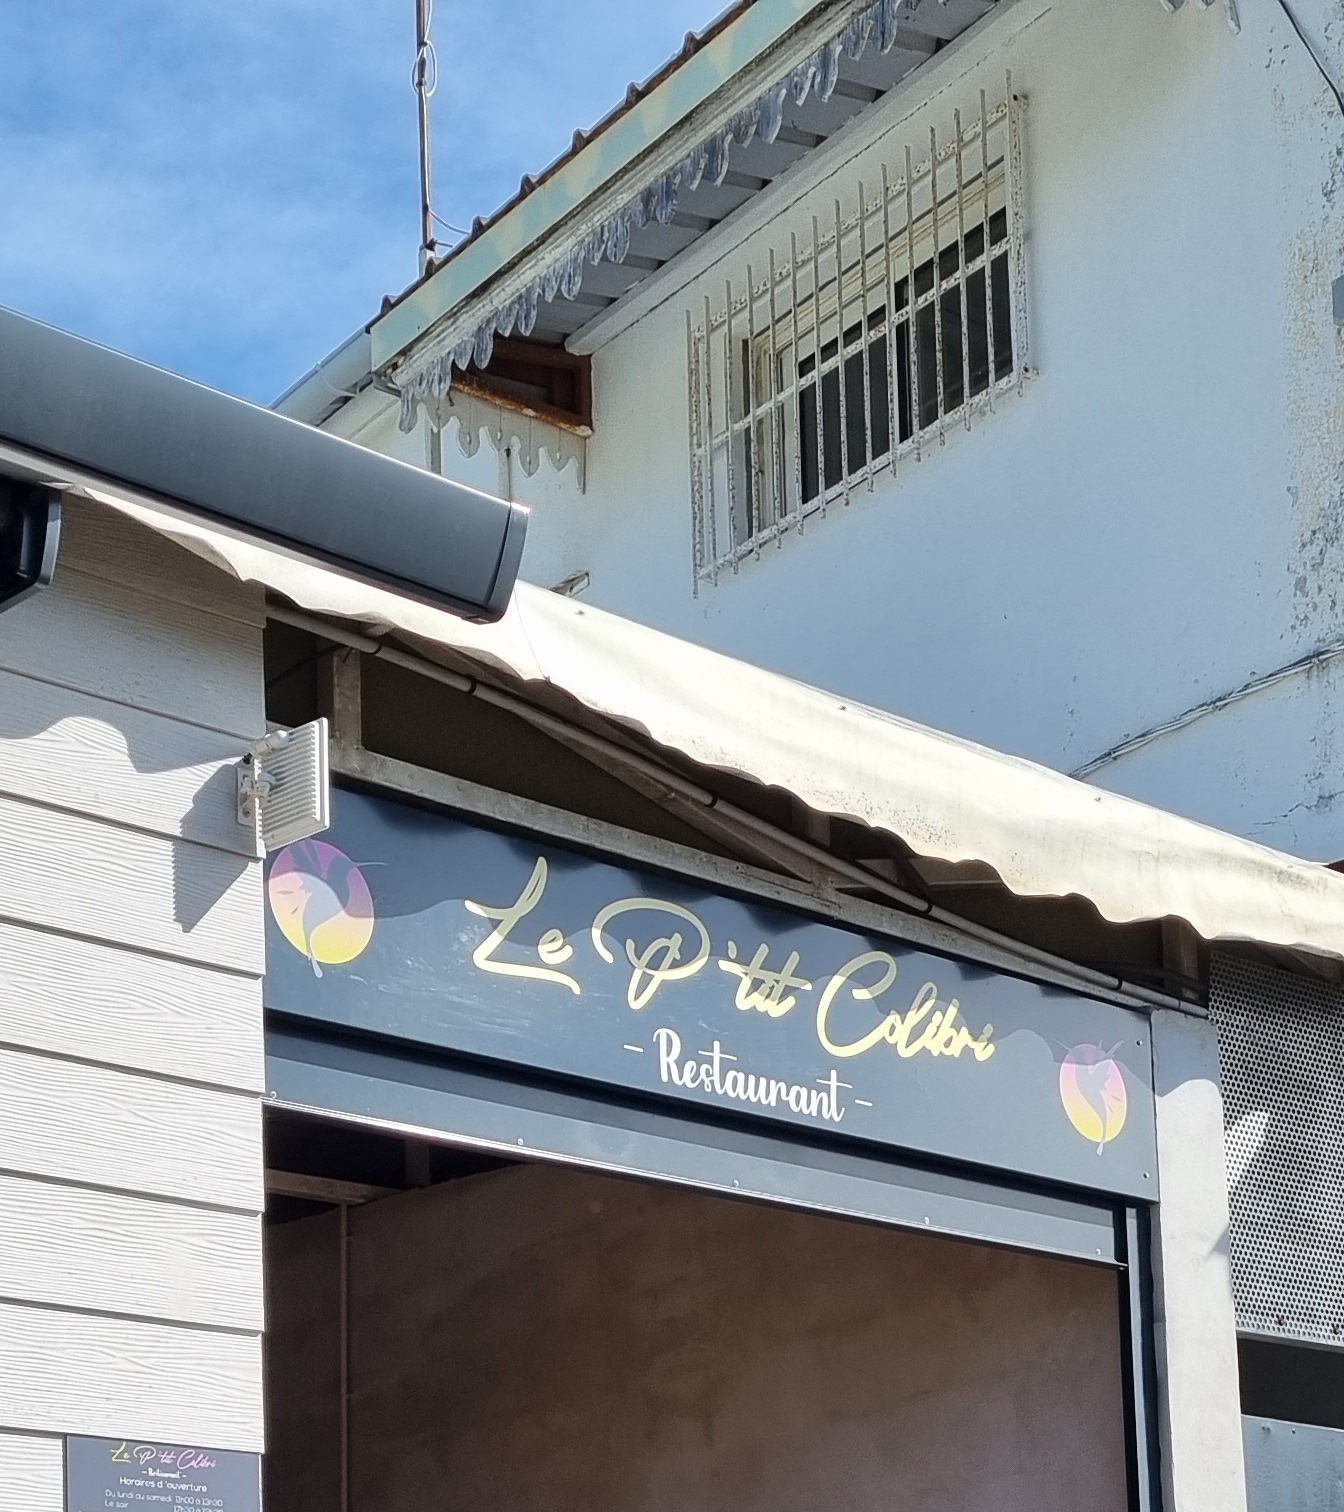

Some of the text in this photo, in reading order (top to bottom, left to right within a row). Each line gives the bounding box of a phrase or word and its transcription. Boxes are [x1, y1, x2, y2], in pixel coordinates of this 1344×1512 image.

[465, 856, 582, 996] Le
[816, 949, 997, 1062] Colibri
[653, 1025, 854, 1124] Restaurant
[110, 1442, 131, 1464] Le
[177, 1449, 216, 1470] Colibri
[119, 1477, 156, 1488] Horaires
